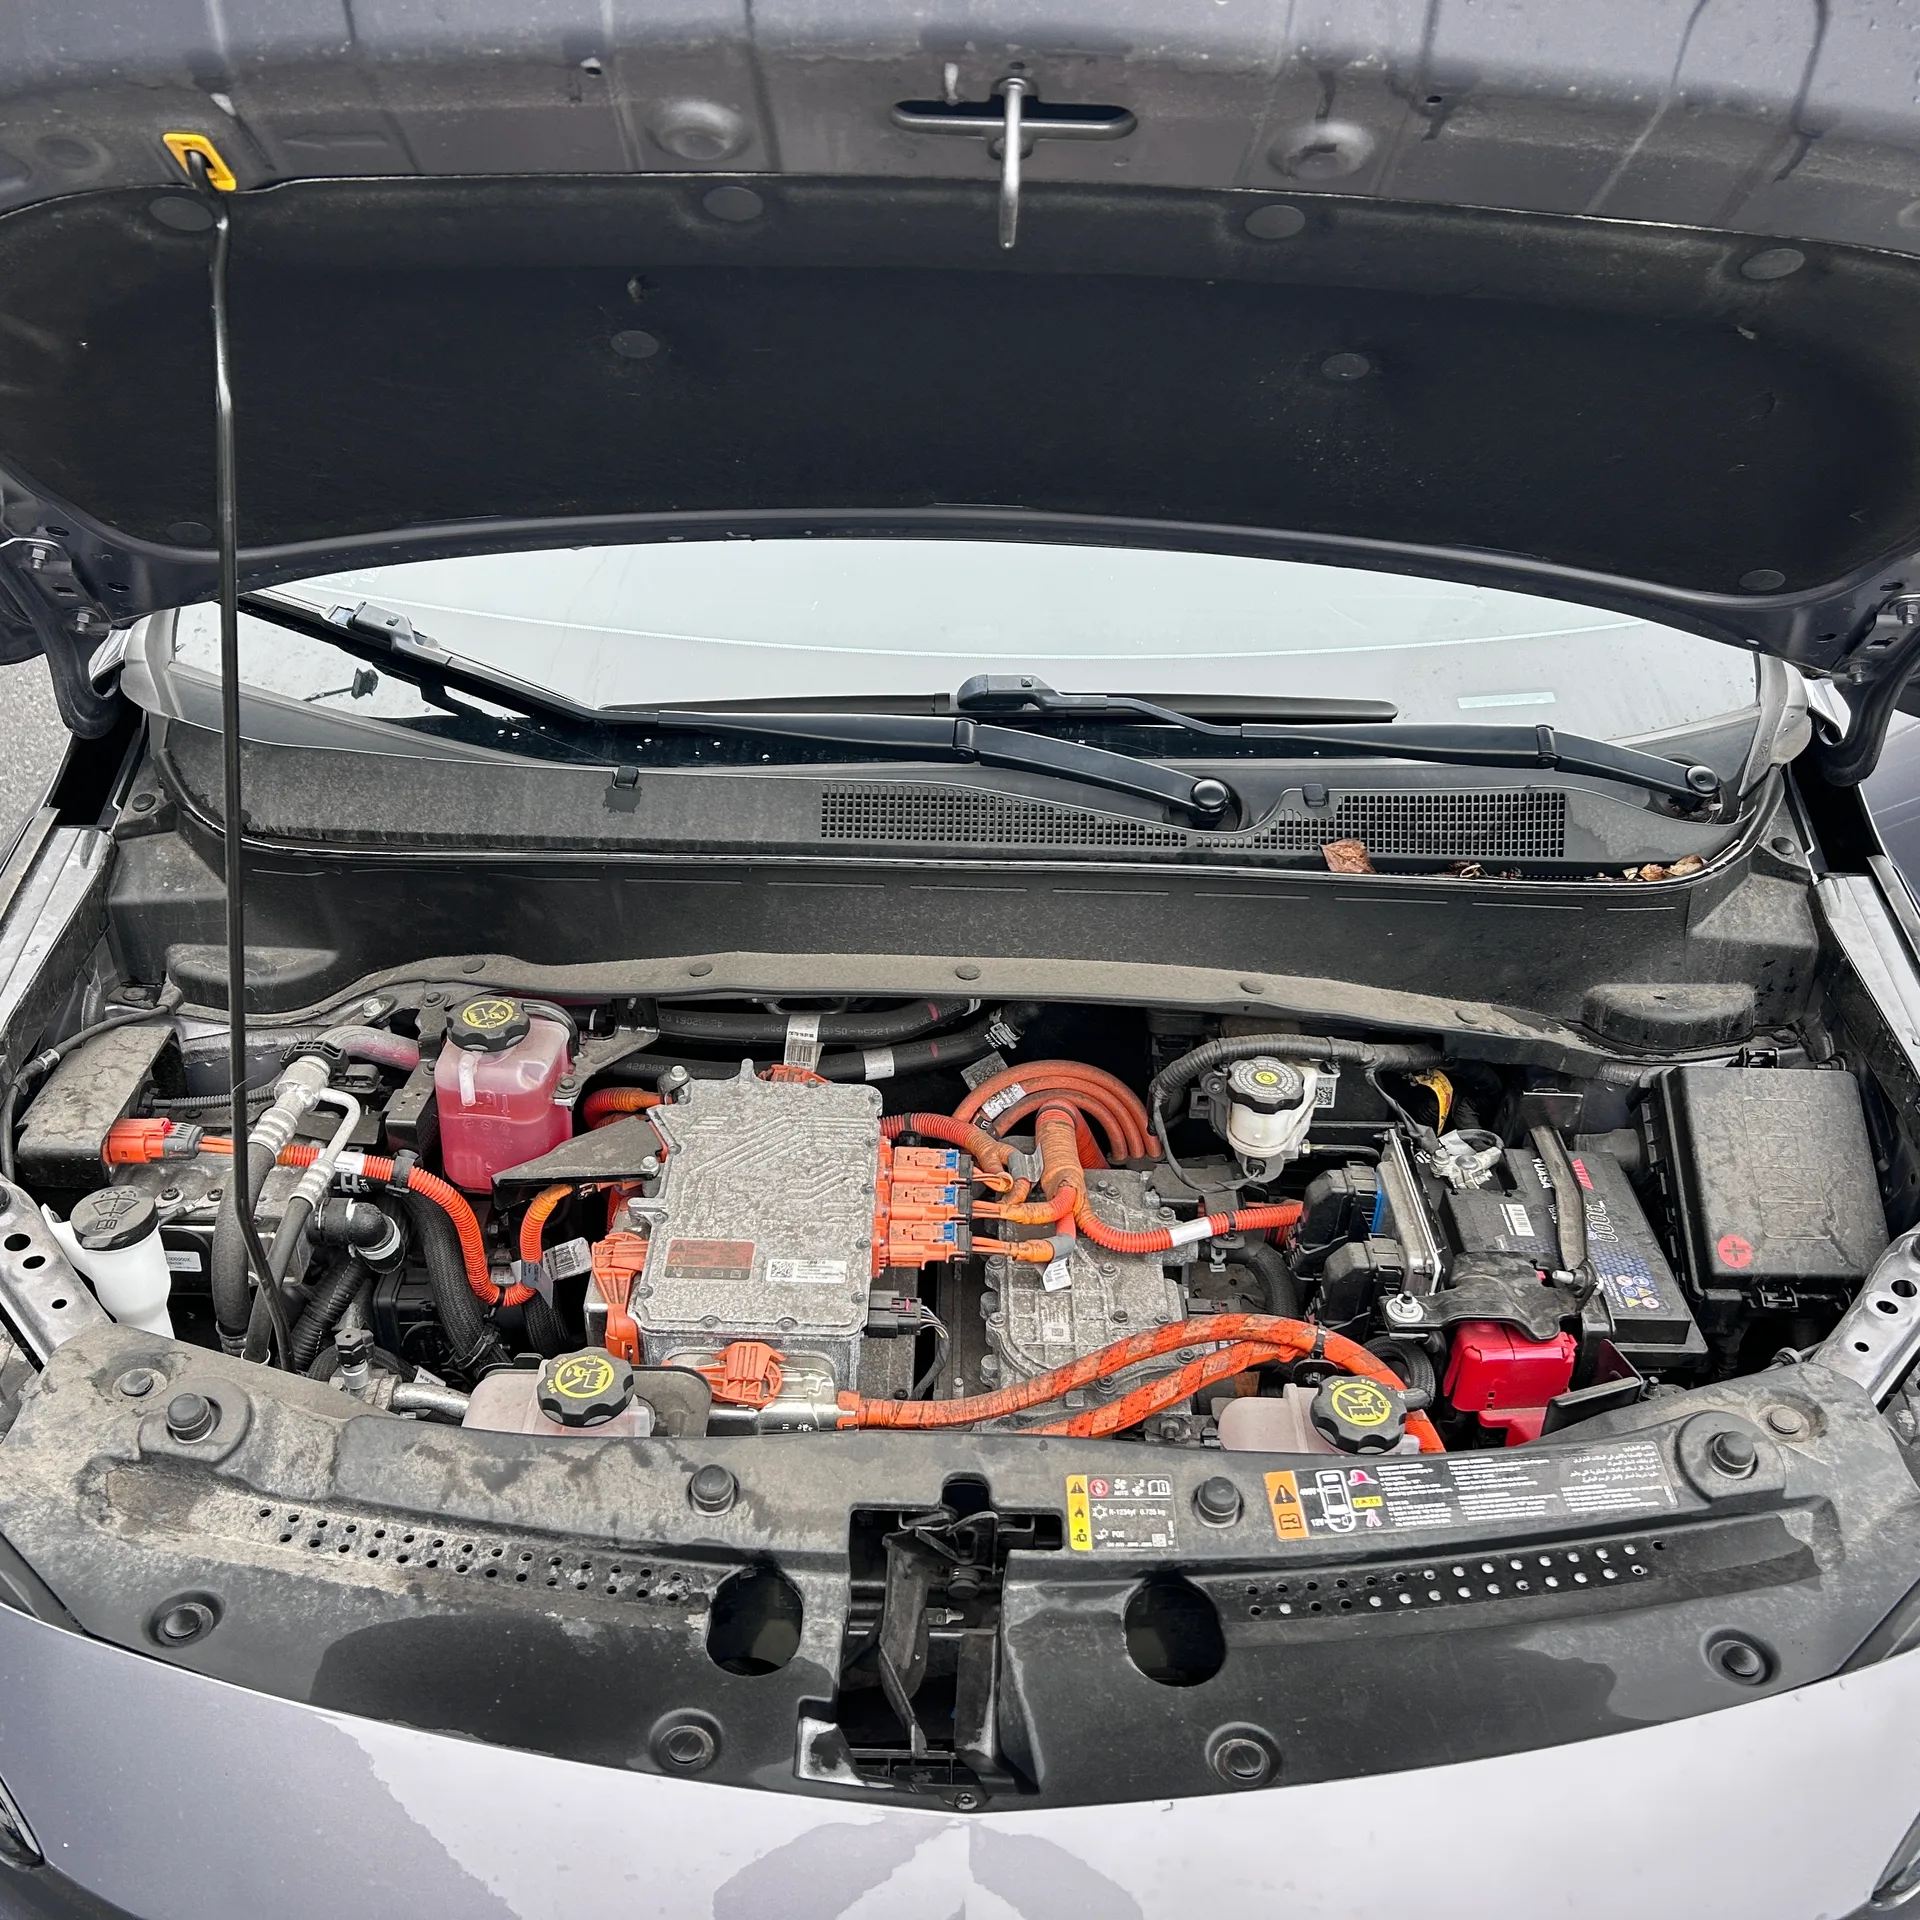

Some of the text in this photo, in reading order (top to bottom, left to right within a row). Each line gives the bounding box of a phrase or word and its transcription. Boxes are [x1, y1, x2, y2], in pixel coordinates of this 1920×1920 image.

[984, 1033, 999, 1049] HVAC
[625, 1061, 674, 1075] 4283893
[1531, 1158, 1555, 1189] YUASA
[1109, 1508, 1136, 1516] R-1234yf
[1111, 1530, 1125, 1538] POE
